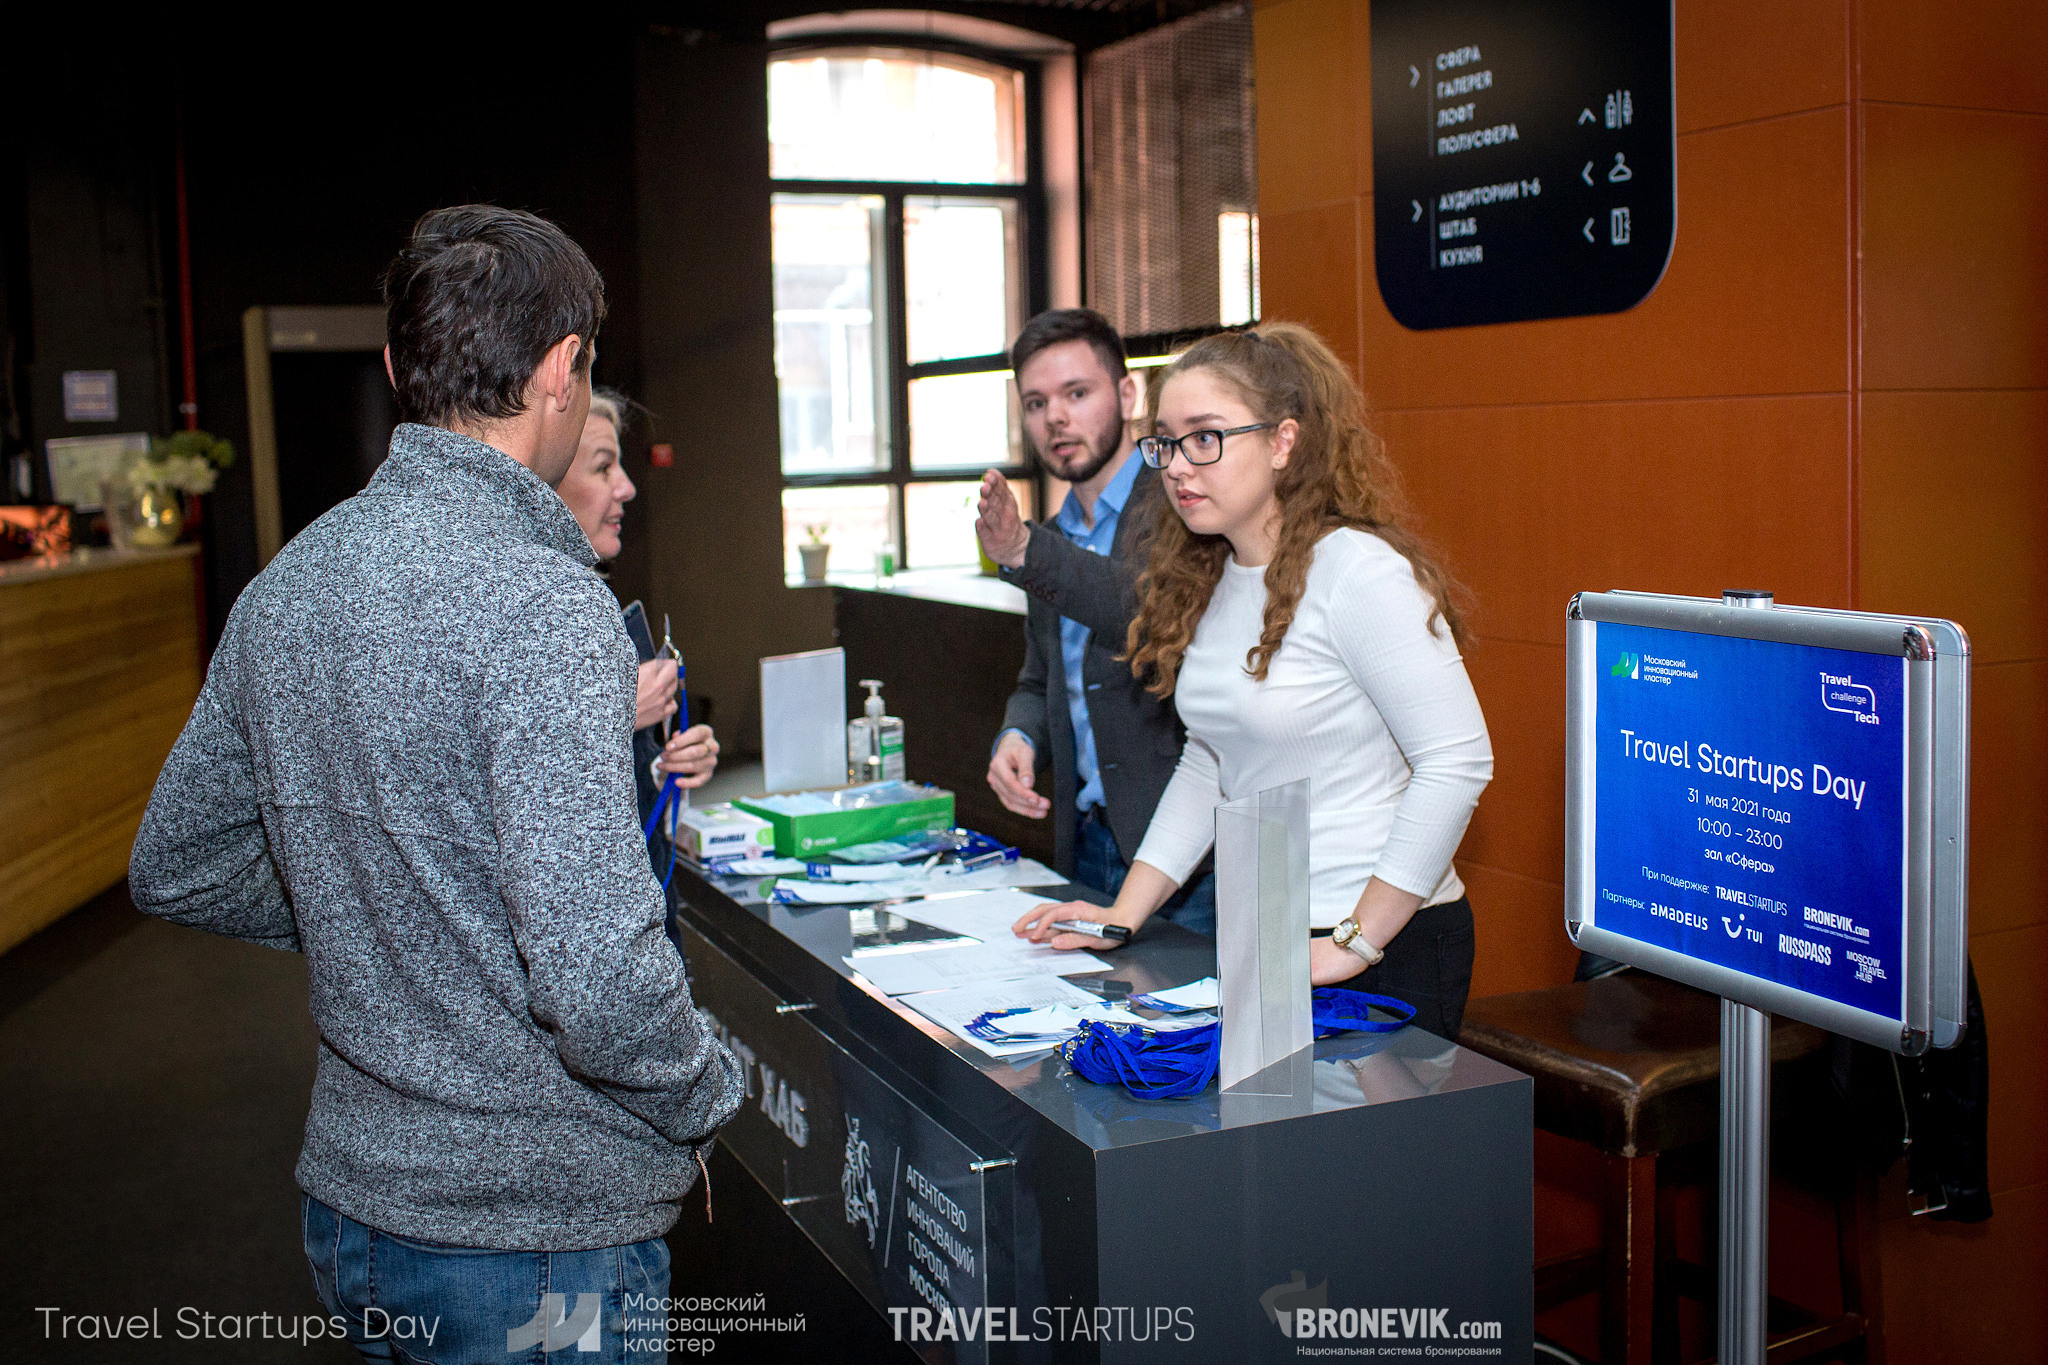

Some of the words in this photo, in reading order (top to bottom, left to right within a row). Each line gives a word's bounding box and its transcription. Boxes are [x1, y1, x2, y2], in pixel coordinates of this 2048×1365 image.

[1436, 45, 1481, 71] СФЕРА
[1436, 70, 1493, 99] ГАЛЕРЕЯ
[1437, 103, 1476, 128] ЛОФТ
[1437, 123, 1519, 155] ПОЛУСФЕРА
[1439, 181, 1519, 211] АУДИТОРИИ
[1521, 177, 1541, 197] 1-6
[1439, 217, 1477, 239] ШТАБ
[1439, 245, 1483, 268] КУХНЯ
[1643, 654, 1686, 668] Московский
[1643, 665, 1698, 679] инновационный
[1643, 674, 1672, 686] кластер
[1819, 672, 1852, 687] Travel
[1830, 691, 1867, 705] challenge
[1853, 710, 1880, 725] Tech
[1620, 729, 1690, 770] Travel
[1697, 743, 1803, 794] Startups
[1812, 764, 1866, 810] Day
[1687, 787, 1699, 804] 31
[1705, 794, 1729, 810] мая
[1731, 796, 1759, 817] 2021
[1762, 806, 1791, 825] года
[1697, 816, 1731, 838] 10:00
[1746, 827, 1783, 850] 23:00
[1704, 848, 1723, 862] зал
[1725, 851, 1775, 874] «Сфера»
[1641, 865, 1659, 881] При
[1660, 873, 1710, 895] поддержке:
[1602, 888, 1646, 910] Партнеры:
[1803, 906, 1870, 938] BRONEVIK.com
[1745, 927, 1763, 945] TUI
[1778, 932, 1832, 966] RUSSPASS
[1846, 950, 1881, 968] MOSCOW
[1858, 962, 1887, 980] TRAVEL
[759, 1061, 809, 1149] ХАБ
[905, 1164, 967, 1233] АГЕНТСТВО
[906, 1196, 975, 1278] ИННОВАЦИЙ
[907, 1230, 950, 1289] ГОРОДА
